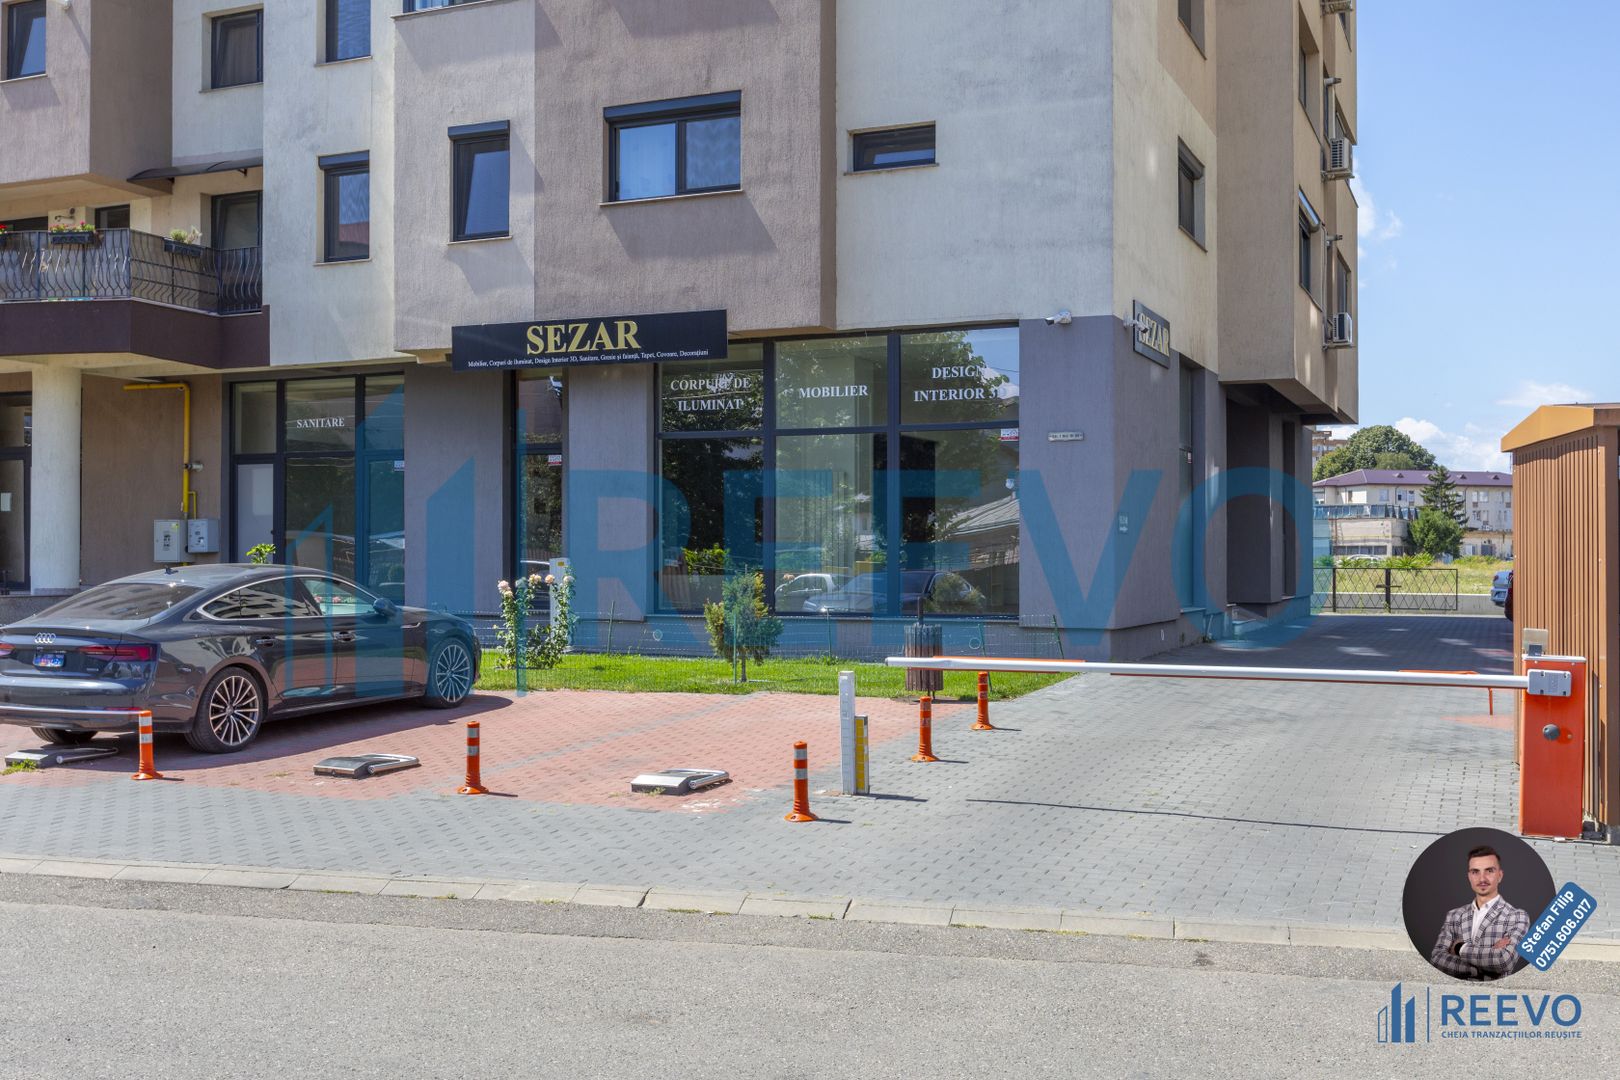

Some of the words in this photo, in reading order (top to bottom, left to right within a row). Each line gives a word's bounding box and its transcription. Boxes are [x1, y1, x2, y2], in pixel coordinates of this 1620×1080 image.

[526, 320, 642, 355] SEZAR
[734, 377, 752, 389] DE
[799, 384, 869, 399] MOBILIER
[913, 387, 985, 402] INTERIOR
[678, 398, 744, 412] ILUMINAT
[296, 416, 345, 429] SANITARE
